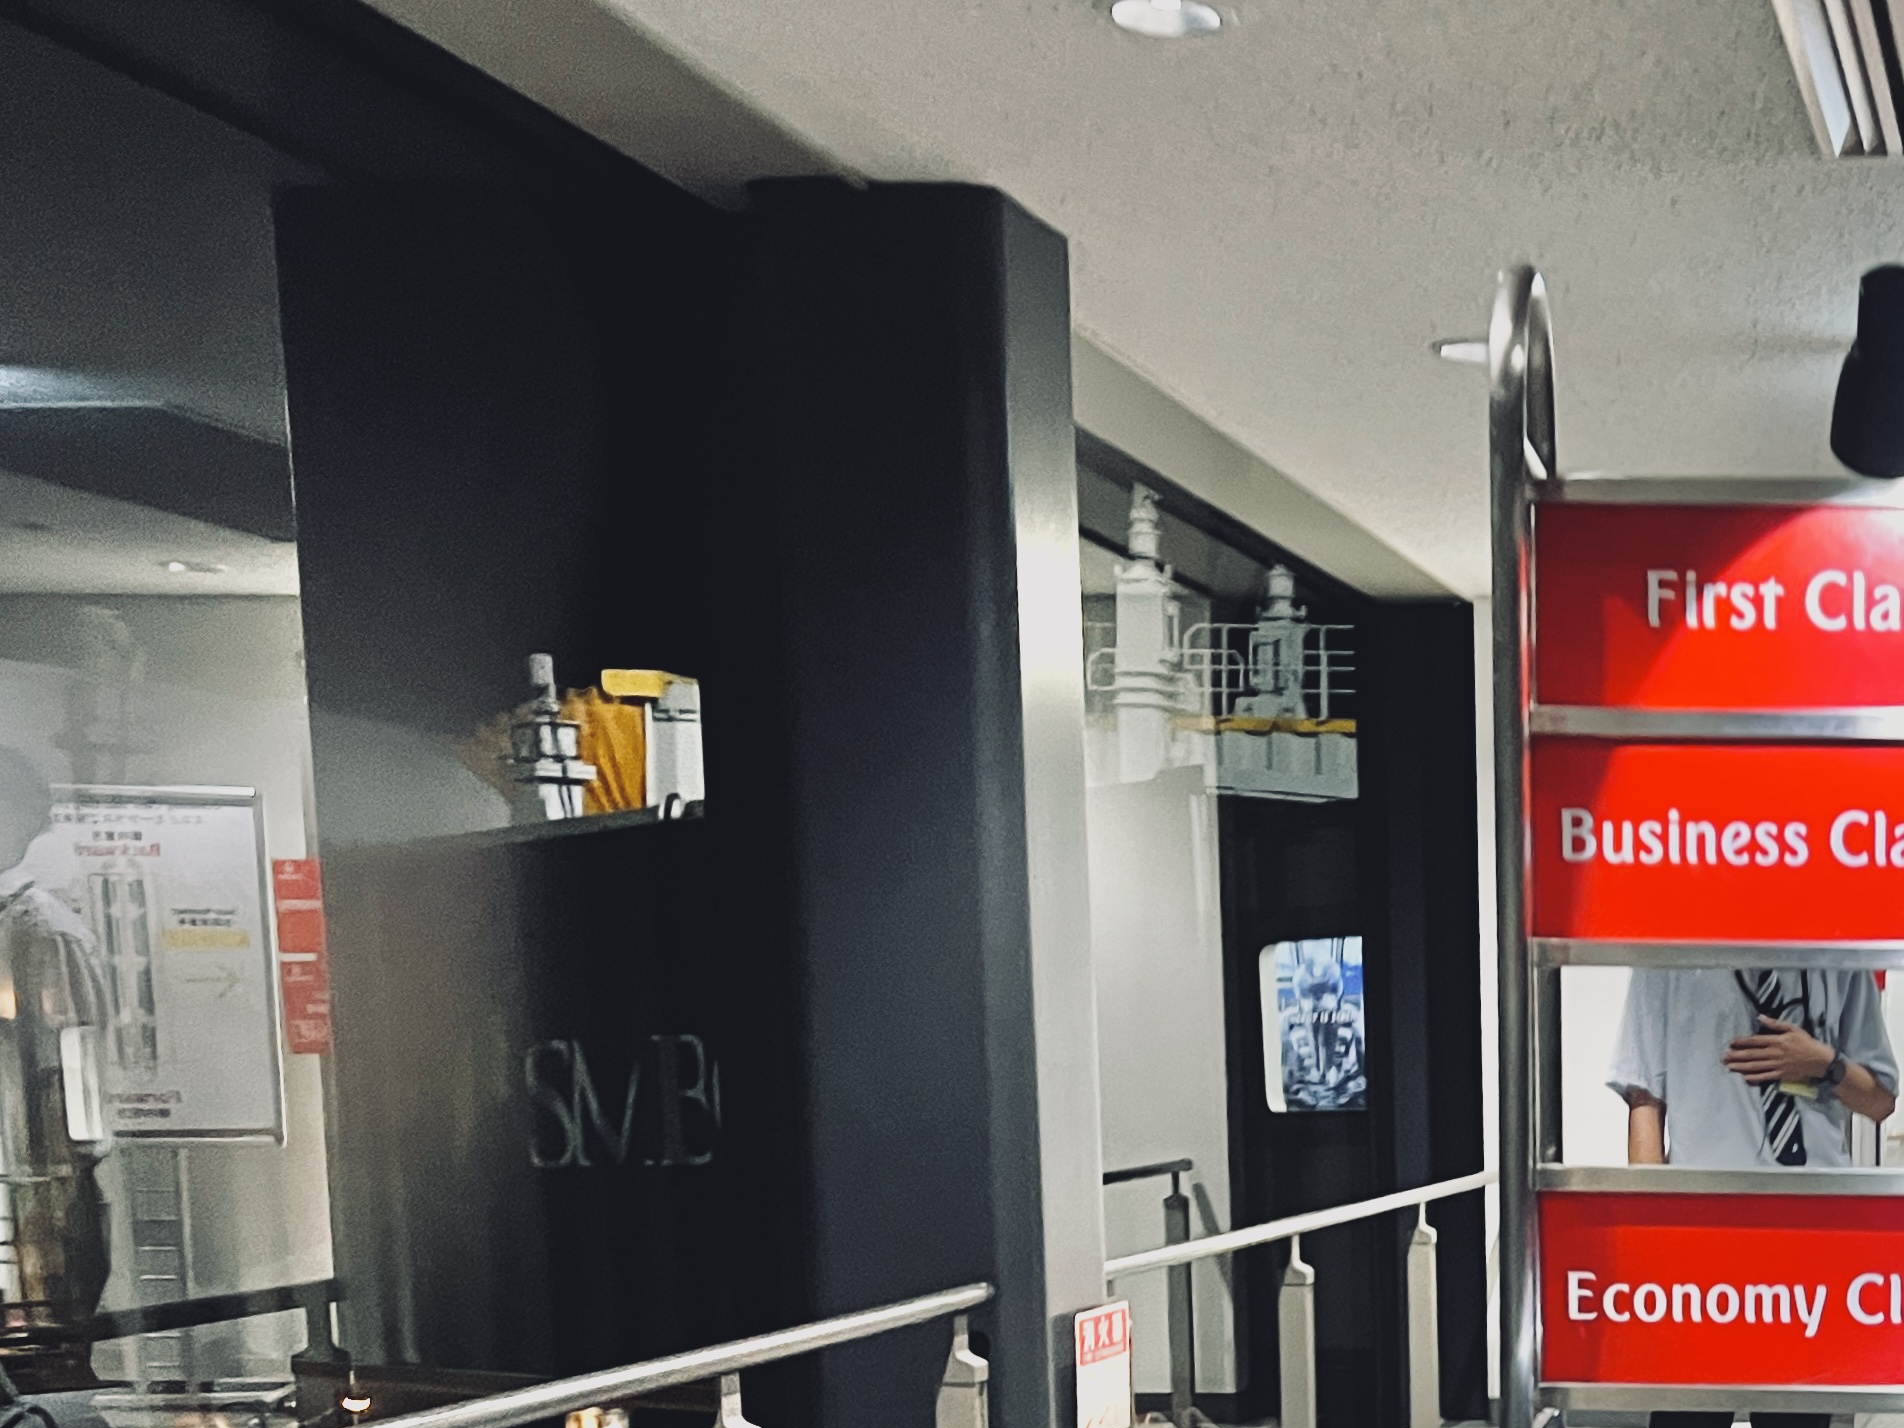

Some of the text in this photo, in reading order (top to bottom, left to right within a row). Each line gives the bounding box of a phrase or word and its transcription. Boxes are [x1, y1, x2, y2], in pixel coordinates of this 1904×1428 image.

[1646, 569, 1786, 632] First
[1560, 807, 1810, 868] Business
[1566, 1270, 1828, 1338] Economy
